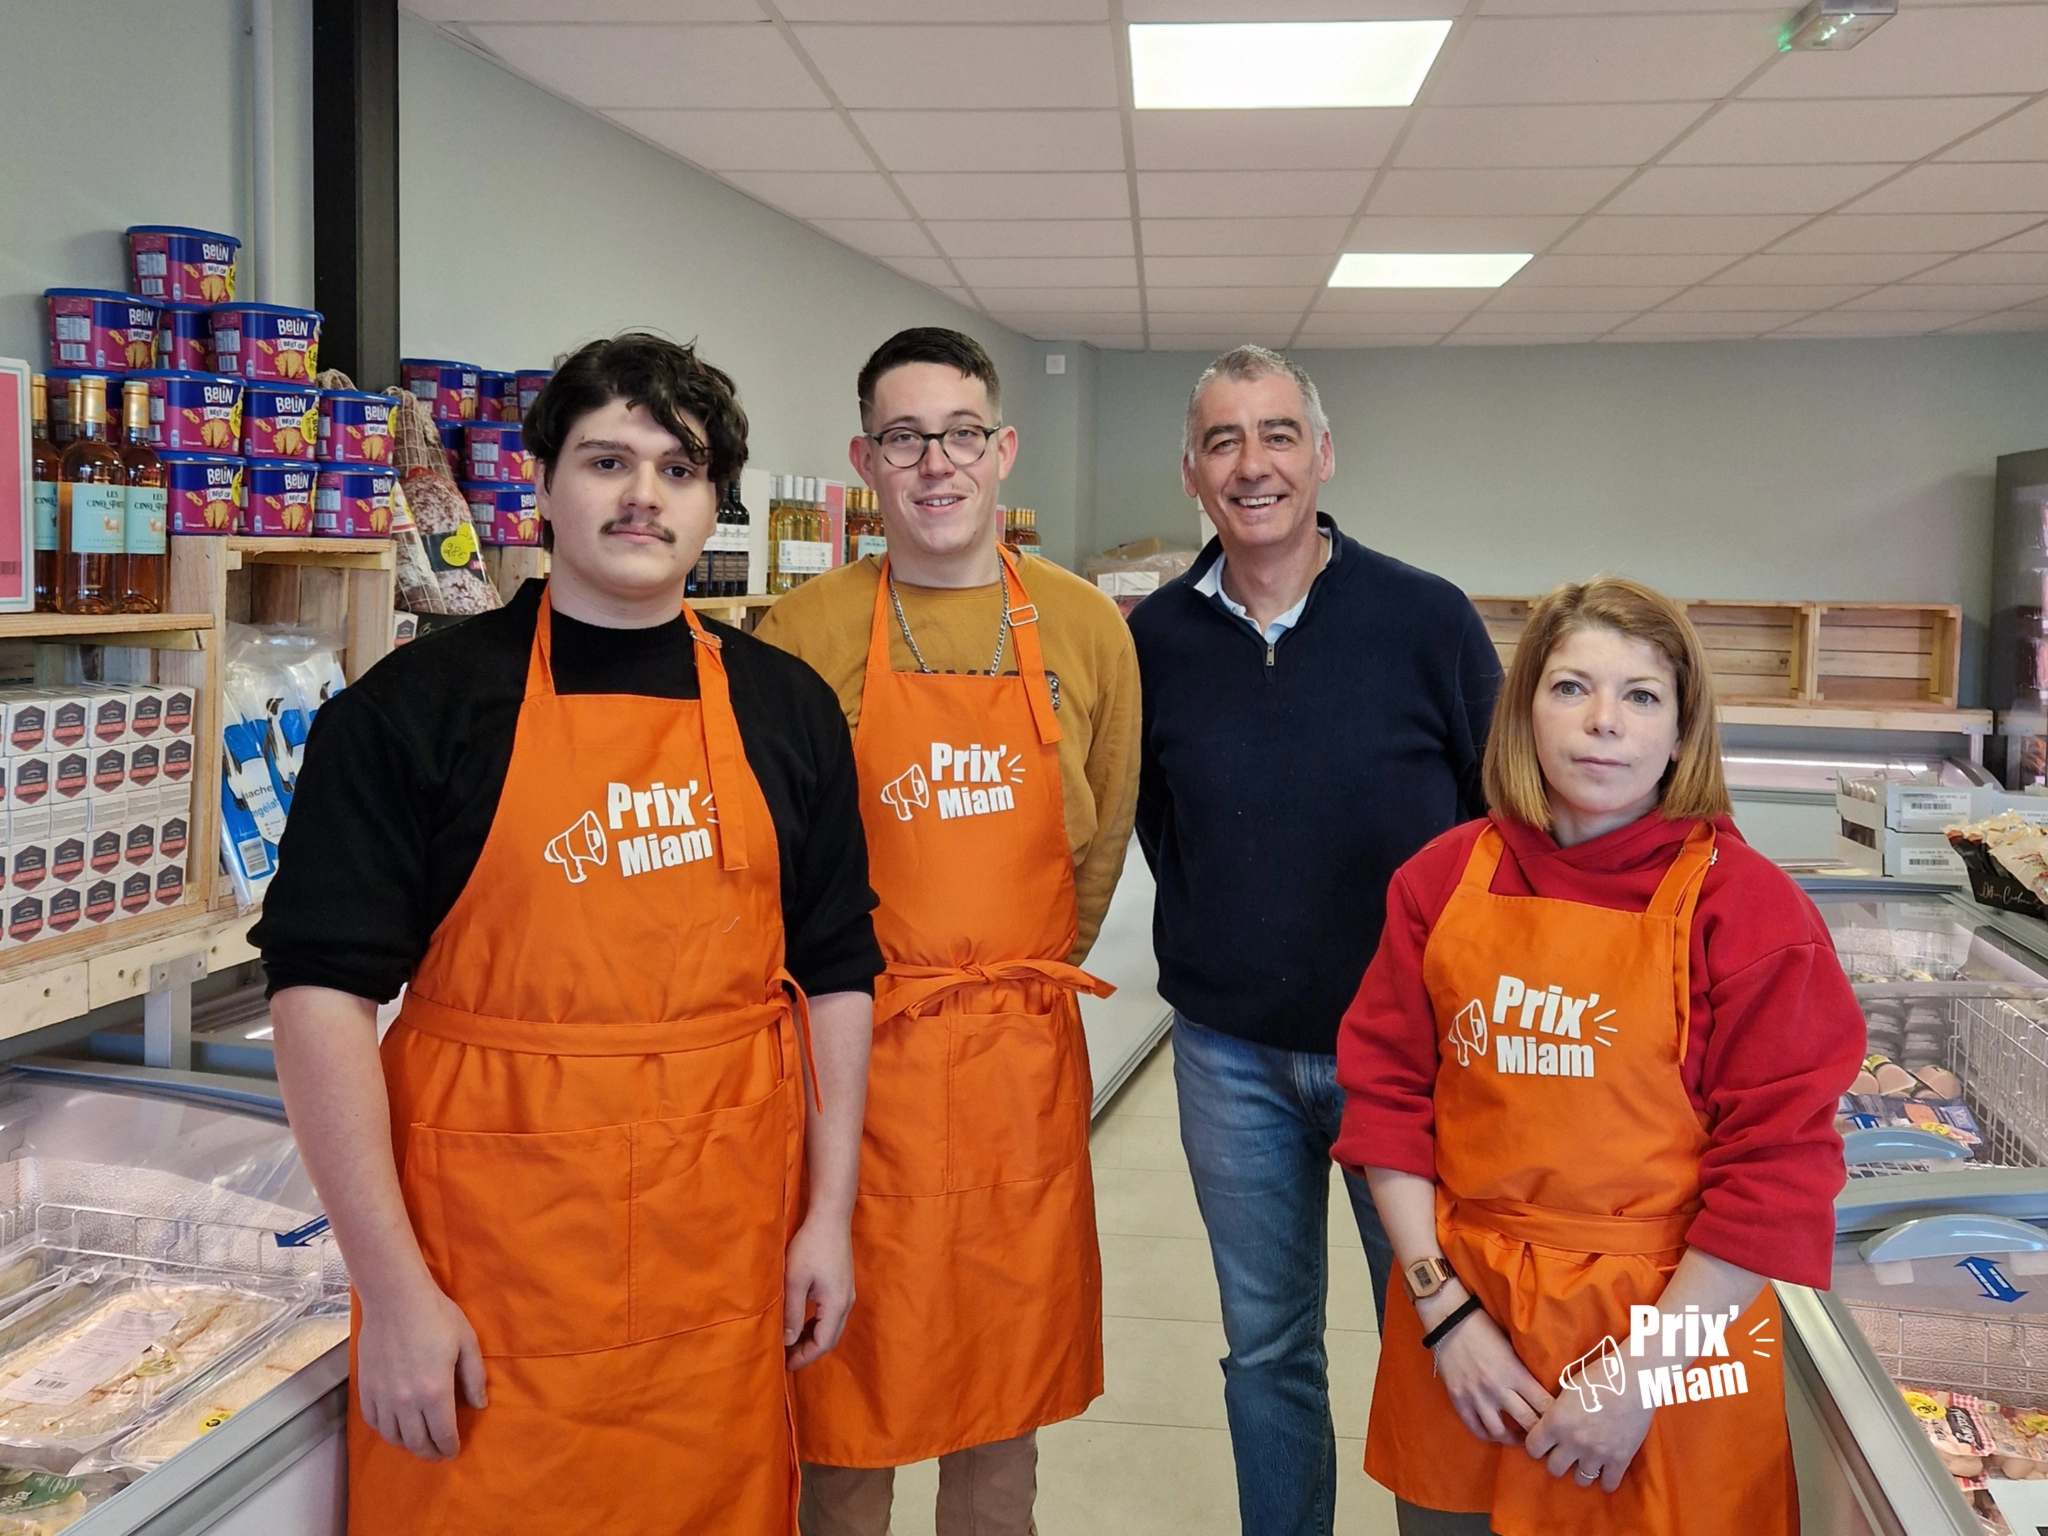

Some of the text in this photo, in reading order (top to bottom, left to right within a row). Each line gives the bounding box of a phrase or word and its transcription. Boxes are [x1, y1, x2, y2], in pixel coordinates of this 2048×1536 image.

[106, 490, 118, 499] LES
[937, 784, 1015, 820] Miam
[617, 828, 713, 878] Miam
[1496, 1035, 1594, 1077] Miam
